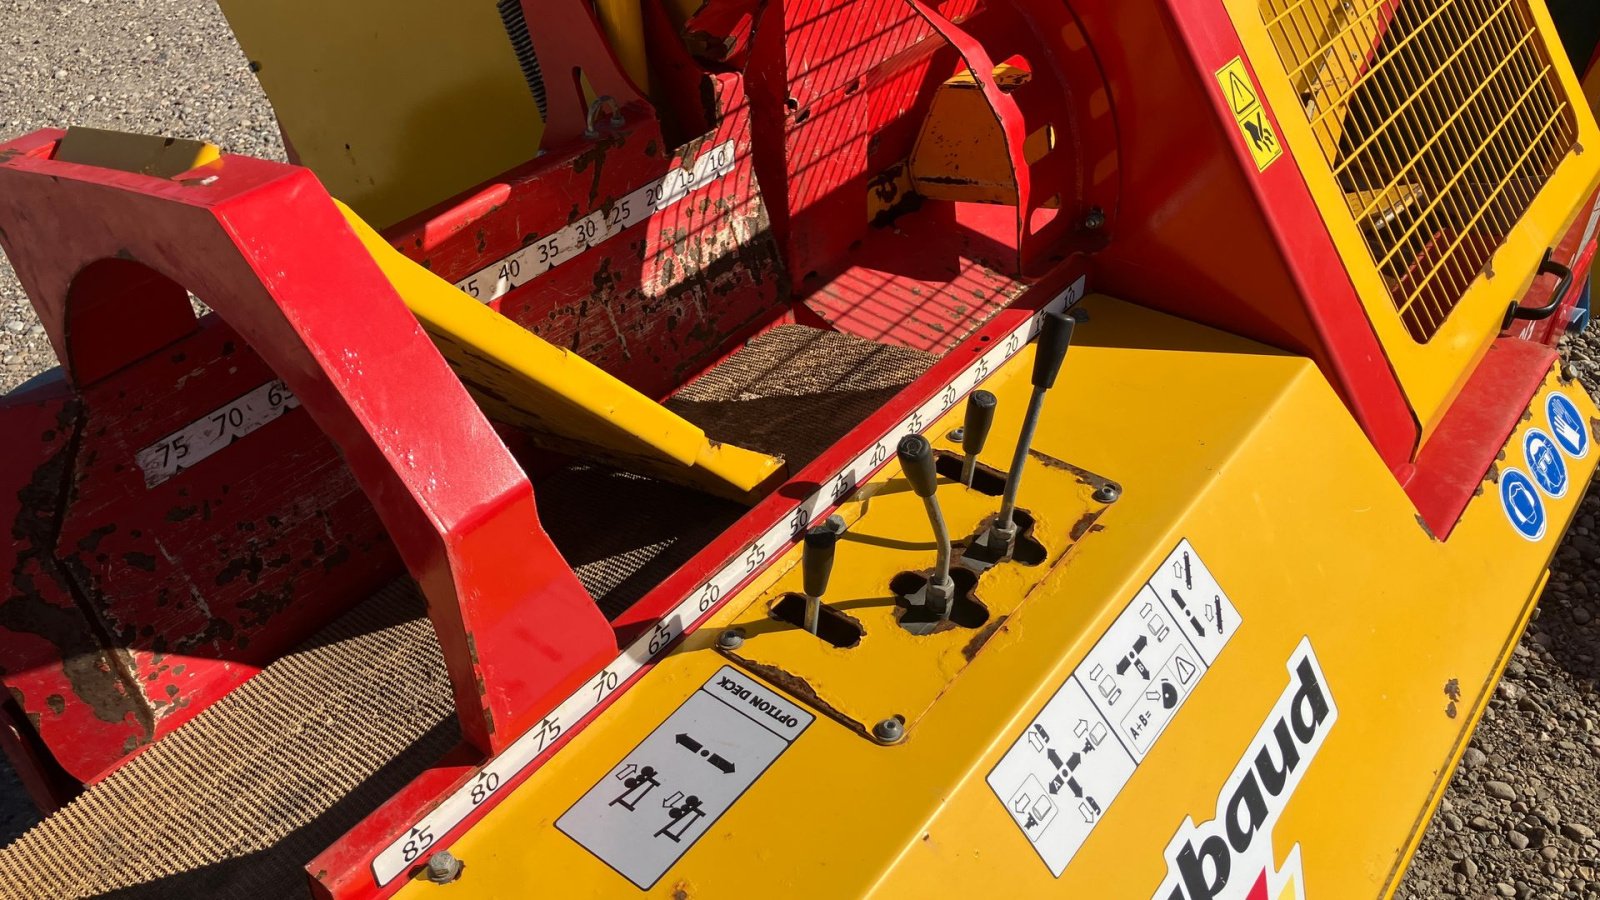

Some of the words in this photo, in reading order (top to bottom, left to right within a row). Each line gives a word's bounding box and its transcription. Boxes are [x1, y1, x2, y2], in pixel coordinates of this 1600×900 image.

[498, 260, 520, 281] 40
[539, 239, 559, 263] 35
[576, 220, 596, 243] 30
[612, 202, 631, 225] 25
[646, 183, 663, 206] 20
[710, 150, 725, 171] 10
[155, 435, 189, 468] 75
[212, 408, 243, 437] 70
[402, 825, 434, 862] 85
[470, 772, 499, 805] 80
[533, 717, 561, 752] 75
[593, 671, 618, 702] 70
[649, 624, 671, 655] 65
[699, 584, 720, 612] 60
[746, 543, 766, 573] 55
[790, 510, 808, 536] 50
[831, 476, 849, 500] 45
[869, 445, 886, 468] 40
[907, 415, 922, 434] 35
[941, 388, 956, 411] 30
[973, 359, 989, 384] 25
[1004, 337, 1019, 359] 20
[1064, 290, 1075, 309] 10
[1137, 663, 1145, 672] B
[716, 676, 752, 700] DECK
[749, 695, 798, 728] OPTION
[1130, 710, 1152, 740] A+B=
[1053, 780, 1061, 791] A
[1167, 655, 1330, 900] baud
